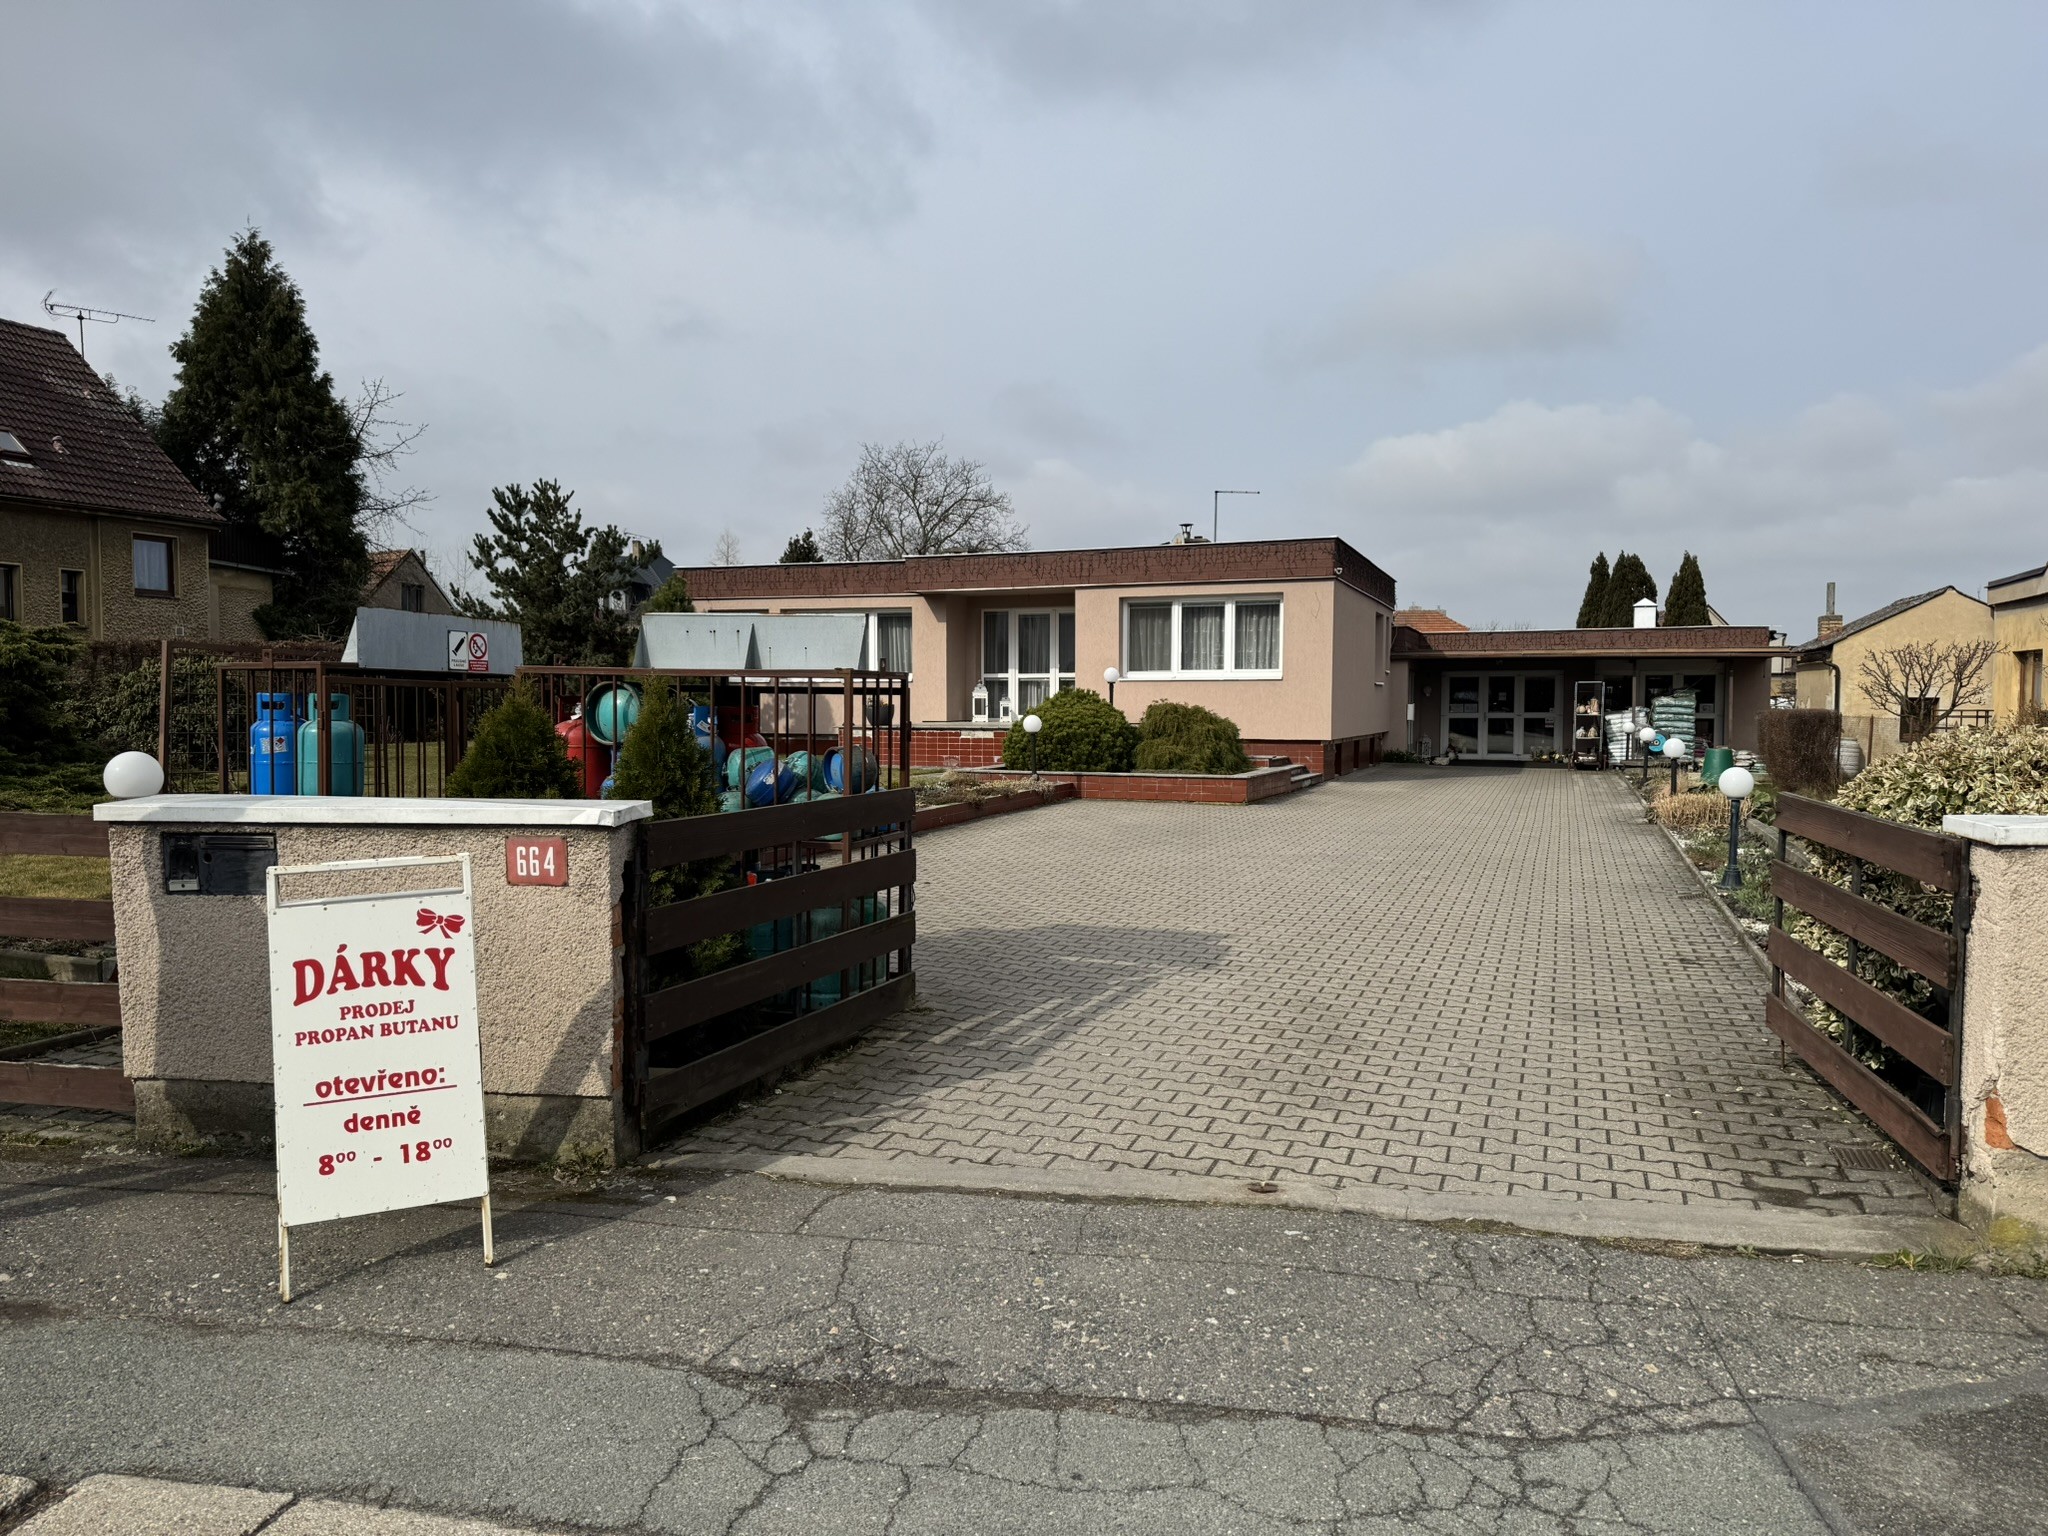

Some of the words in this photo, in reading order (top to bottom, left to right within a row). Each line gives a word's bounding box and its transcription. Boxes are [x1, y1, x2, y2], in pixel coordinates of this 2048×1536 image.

[516, 846, 556, 877] 664
[292, 943, 456, 1007] DÁRKY
[340, 1000, 415, 1021] PRODEJ
[295, 1026, 374, 1047] PROPAN
[380, 1015, 459, 1038] BUTANU
[315, 1067, 446, 1099] otevřeno:
[343, 1105, 421, 1134] denně
